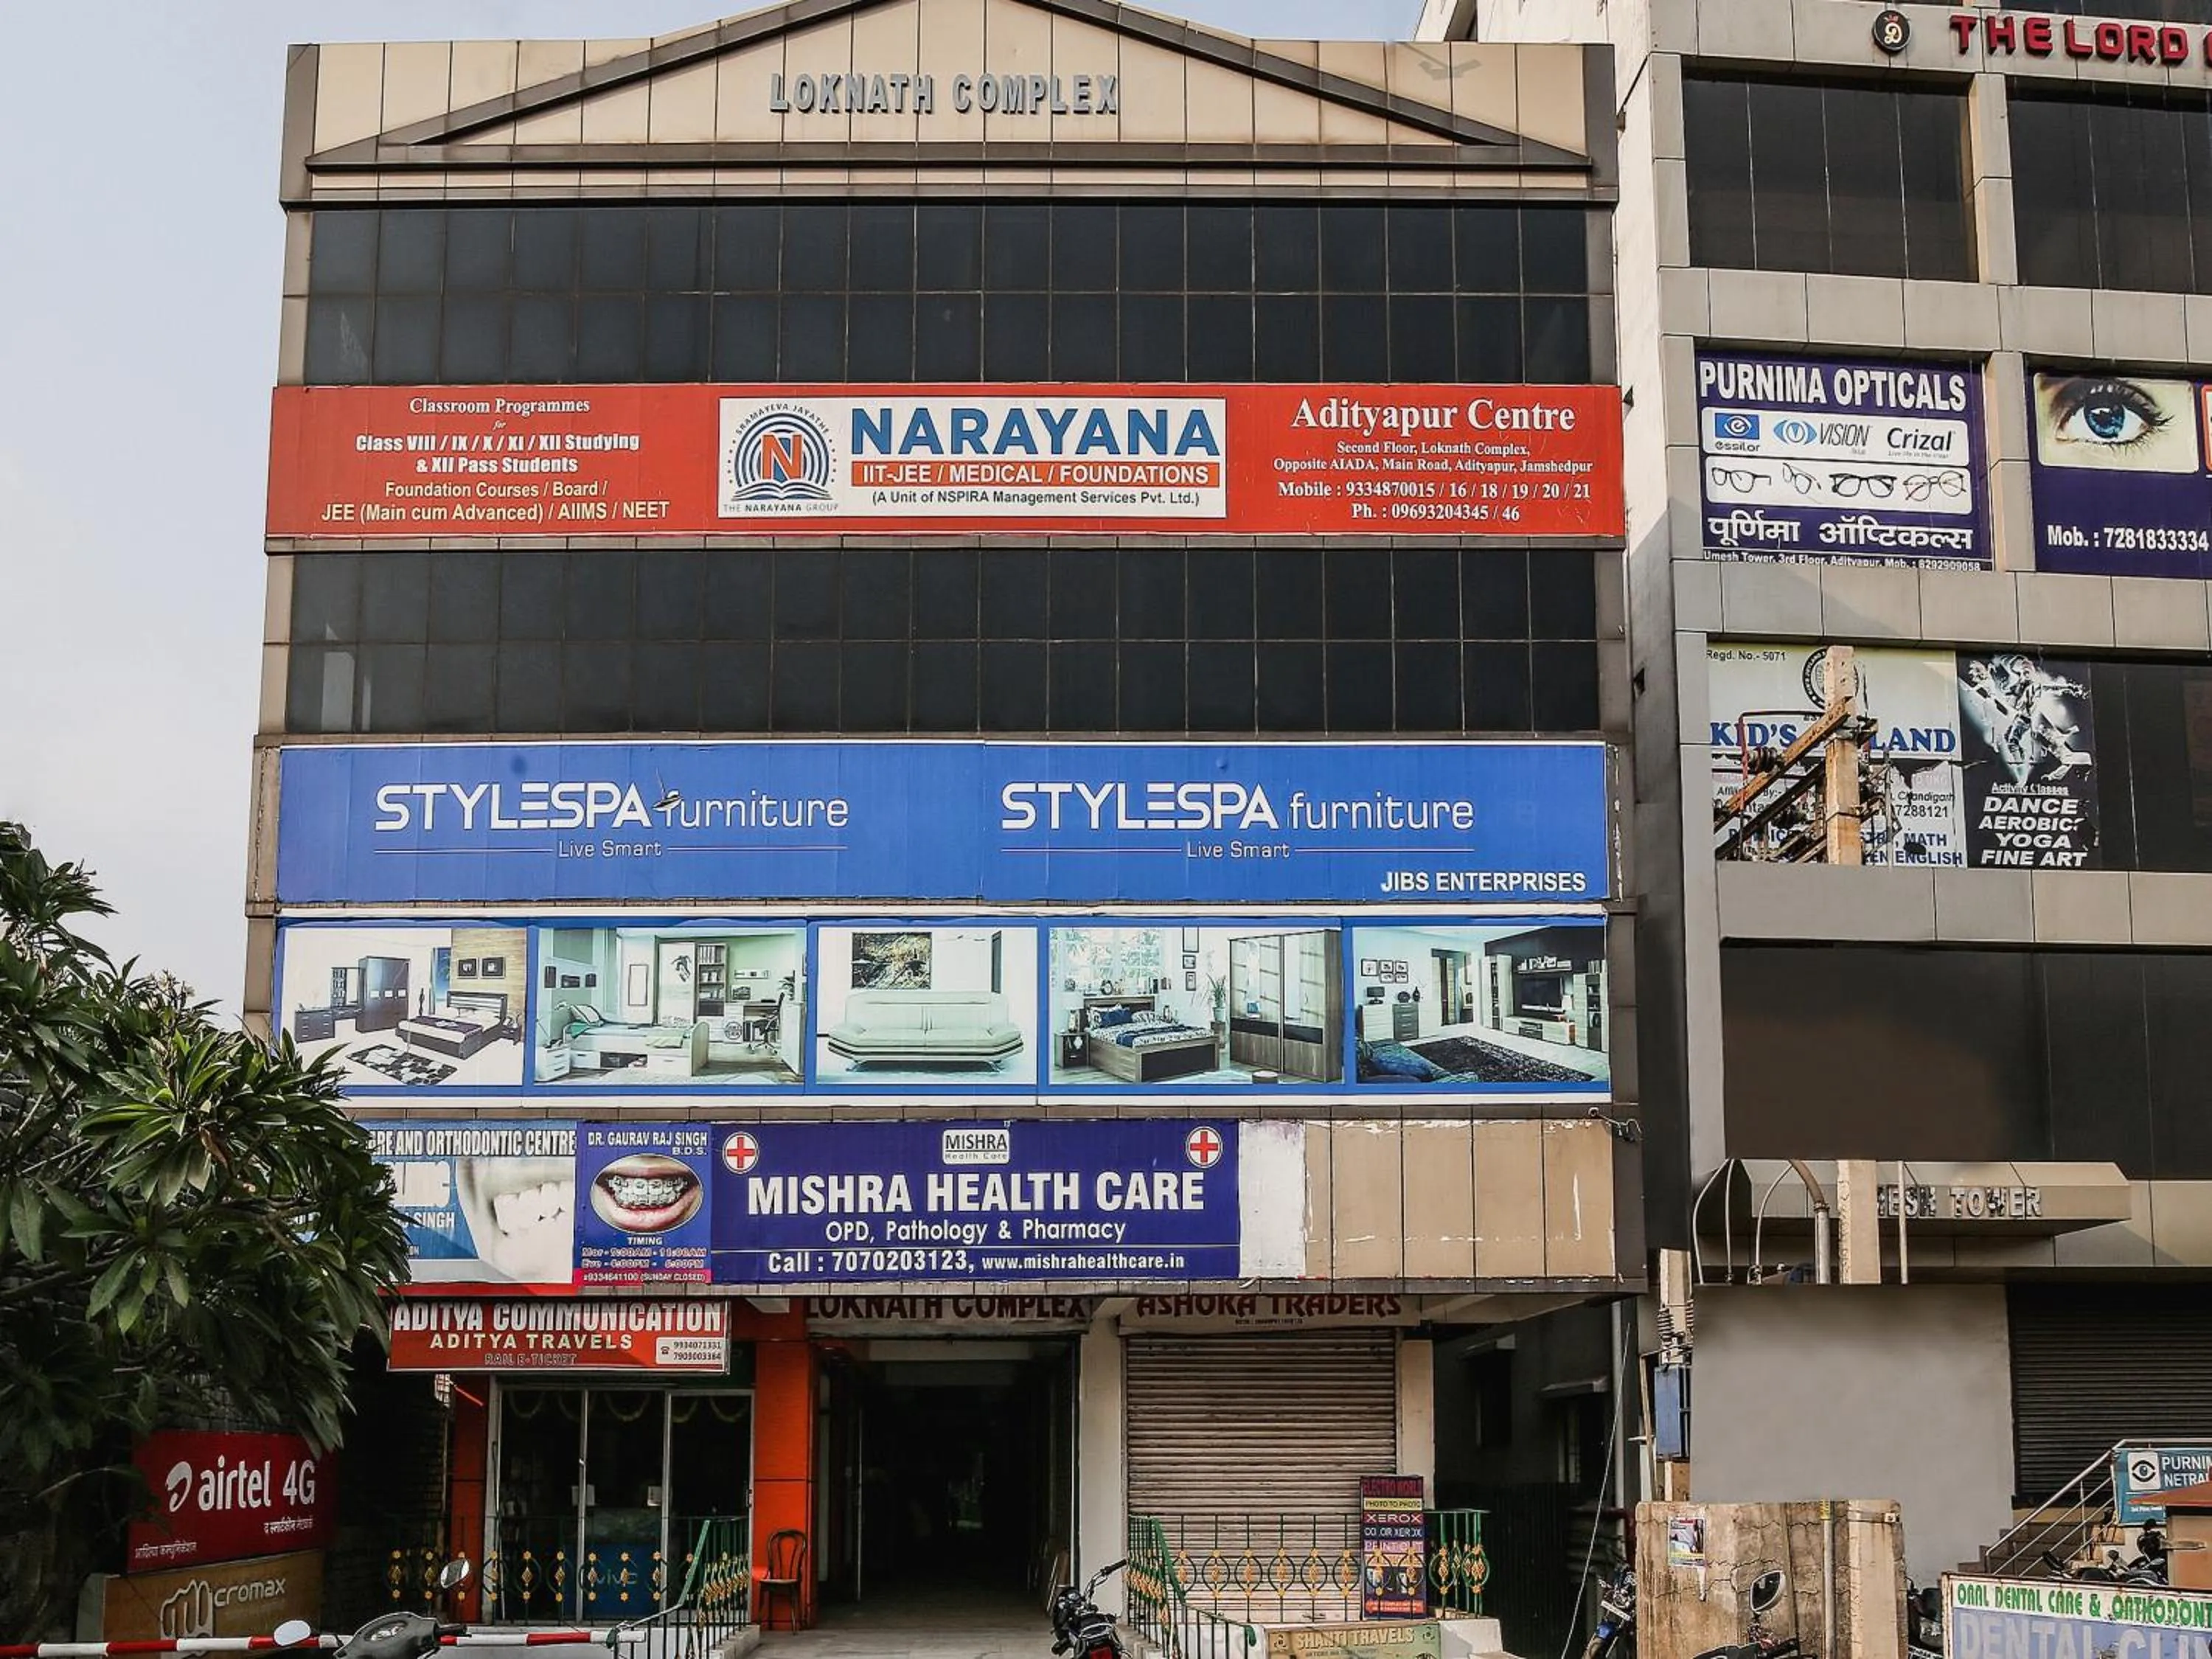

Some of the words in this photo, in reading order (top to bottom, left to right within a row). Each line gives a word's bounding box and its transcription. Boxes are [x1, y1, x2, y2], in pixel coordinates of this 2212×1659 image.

[1950, 15, 2053, 55] THE
[2064, 19, 2188, 64] LORD
[770, 73, 933, 114] LOKNATH
[952, 73, 1117, 114] COMPLEX
[1700, 361, 1827, 404] PURNIMA
[1834, 369, 1966, 412] OPTICALS
[410, 398, 490, 414] Classroom
[495, 398, 591, 417] Programmes
[493, 420, 507, 431] for
[1291, 398, 1457, 437] Adityapur
[1467, 399, 1576, 431] Centre
[851, 407, 1220, 456] NARAYANA
[1820, 422, 1871, 447] VISION
[1887, 427, 1953, 451] Crizal
[355, 435, 403, 451] Class
[406, 435, 437, 451] VIII
[451, 436, 468, 451] IX
[483, 436, 493, 451] X
[507, 436, 525, 451] XI
[540, 435, 561, 451] XII
[565, 434, 640, 452] Studying
[1337, 442, 1380, 454] Second
[1382, 442, 1419, 456] Floor,
[1421, 442, 1472, 454] Loknath
[1475, 443, 1531, 457] Complex,
[1714, 442, 1761, 452] essilor
[416, 458, 428, 473] &
[431, 456, 454, 473] XII
[457, 457, 498, 473] Pass
[502, 456, 578, 473] Students
[862, 464, 932, 484] IIT-JEE
[949, 464, 1041, 484] MEDICAL
[1059, 464, 1208, 484] FOUNDATIONS
[1273, 457, 1328, 471] Opposite
[1382, 459, 1413, 470] Main
[1416, 459, 1453, 472] Road,
[1454, 459, 1517, 473] Adityapur,
[1520, 459, 1593, 474] Jamshedpur
[385, 481, 473, 498] Foundation
[476, 481, 539, 498] Courses
[553, 481, 599, 496] Board
[872, 490, 888, 506] (A
[890, 491, 917, 504] Unit
[919, 491, 935, 504] of
[937, 490, 990, 504] NSPIRA
[992, 491, 1077, 507] Management
[1080, 492, 1136, 504] Services
[1141, 492, 1166, 504] Pvt.
[1169, 491, 1200, 507] Ltd.)
[1278, 481, 1333, 498] Mobile
[1345, 482, 1436, 498] 9334870015
[1450, 483, 1467, 498] 16
[1481, 483, 1499, 498] 18
[1512, 484, 1529, 499] 19
[1542, 484, 1560, 499] 20
[1573, 484, 1590, 499] 21
[322, 504, 355, 521] JEE
[360, 502, 407, 524] (Main
[411, 507, 448, 521] cum
[452, 501, 543, 524] Advanced)
[557, 501, 608, 520] AIIMS
[622, 501, 670, 518] NEET
[745, 504, 801, 512] NARAYANA
[1352, 505, 1377, 519] Ph.
[1391, 505, 1489, 520] 09693204345
[1502, 507, 1520, 521] 46
[1707, 509, 1801, 547] पूर्णिमा
[2047, 524, 2089, 546] Mob.
[2104, 526, 2210, 552] 7281833334
[1762, 651, 1787, 662] 5071
[374, 782, 653, 830] STYLESPA
[662, 790, 849, 829] furniture
[1001, 782, 1279, 830] STYLESPA
[1290, 791, 1475, 830] furniture
[1983, 796, 2079, 814] DANCE
[558, 841, 596, 858] Live
[601, 841, 662, 858] Smart
[1186, 841, 1224, 859] Live
[1229, 841, 1290, 859] Smart
[1994, 832, 2072, 849] YOGA
[1895, 851, 1963, 865] ENGLISH
[1980, 849, 2035, 865] FINE
[2039, 851, 2088, 866] ART
[1380, 872, 1430, 892] JIBS
[1435, 872, 1587, 893] ENTERPRISES
[395, 1130, 423, 1155] AND
[426, 1130, 523, 1156] ORTHODONTIC
[525, 1130, 576, 1156] CENTRE
[588, 1131, 605, 1146] DR.
[608, 1132, 650, 1147] GAURAV
[652, 1133, 673, 1146] RAJ
[675, 1133, 708, 1147] SINGH
[945, 1133, 1008, 1150] MISHRA
[748, 1175, 914, 1215] MISHRA
[927, 1172, 1079, 1211] HEALTH
[1096, 1171, 1205, 1211] CARE
[1950, 1185, 2042, 1218] TOWER
[825, 1220, 874, 1245] OPD,
[886, 1219, 987, 1245] Pathology
[998, 1222, 1012, 1239] &
[1023, 1218, 1127, 1243] Pharmacy
[626, 1237, 664, 1246] TIMING
[768, 1253, 810, 1273] Call
[832, 1250, 975, 1275] 7070203123,
[981, 1253, 1184, 1270] www.mishrahealthcare.in
[952, 1295, 1086, 1318] COMPLEX
[1136, 1295, 1253, 1317] ASHOKA
[1269, 1295, 1401, 1318] TRADERS
[394, 1302, 483, 1331] ADITYA
[493, 1302, 721, 1332] COMMUNICATION
[430, 1334, 517, 1349] ADITYA
[526, 1333, 633, 1349] TRAVELS
[198, 1455, 271, 1512] airtel
[282, 1459, 316, 1506] 4G
[1366, 1514, 1422, 1523] XEROX
[1995, 1585, 2042, 1612] DENTAL
[2048, 1590, 2083, 1615] CARE
[1349, 1627, 1415, 1646] TRAVELS
